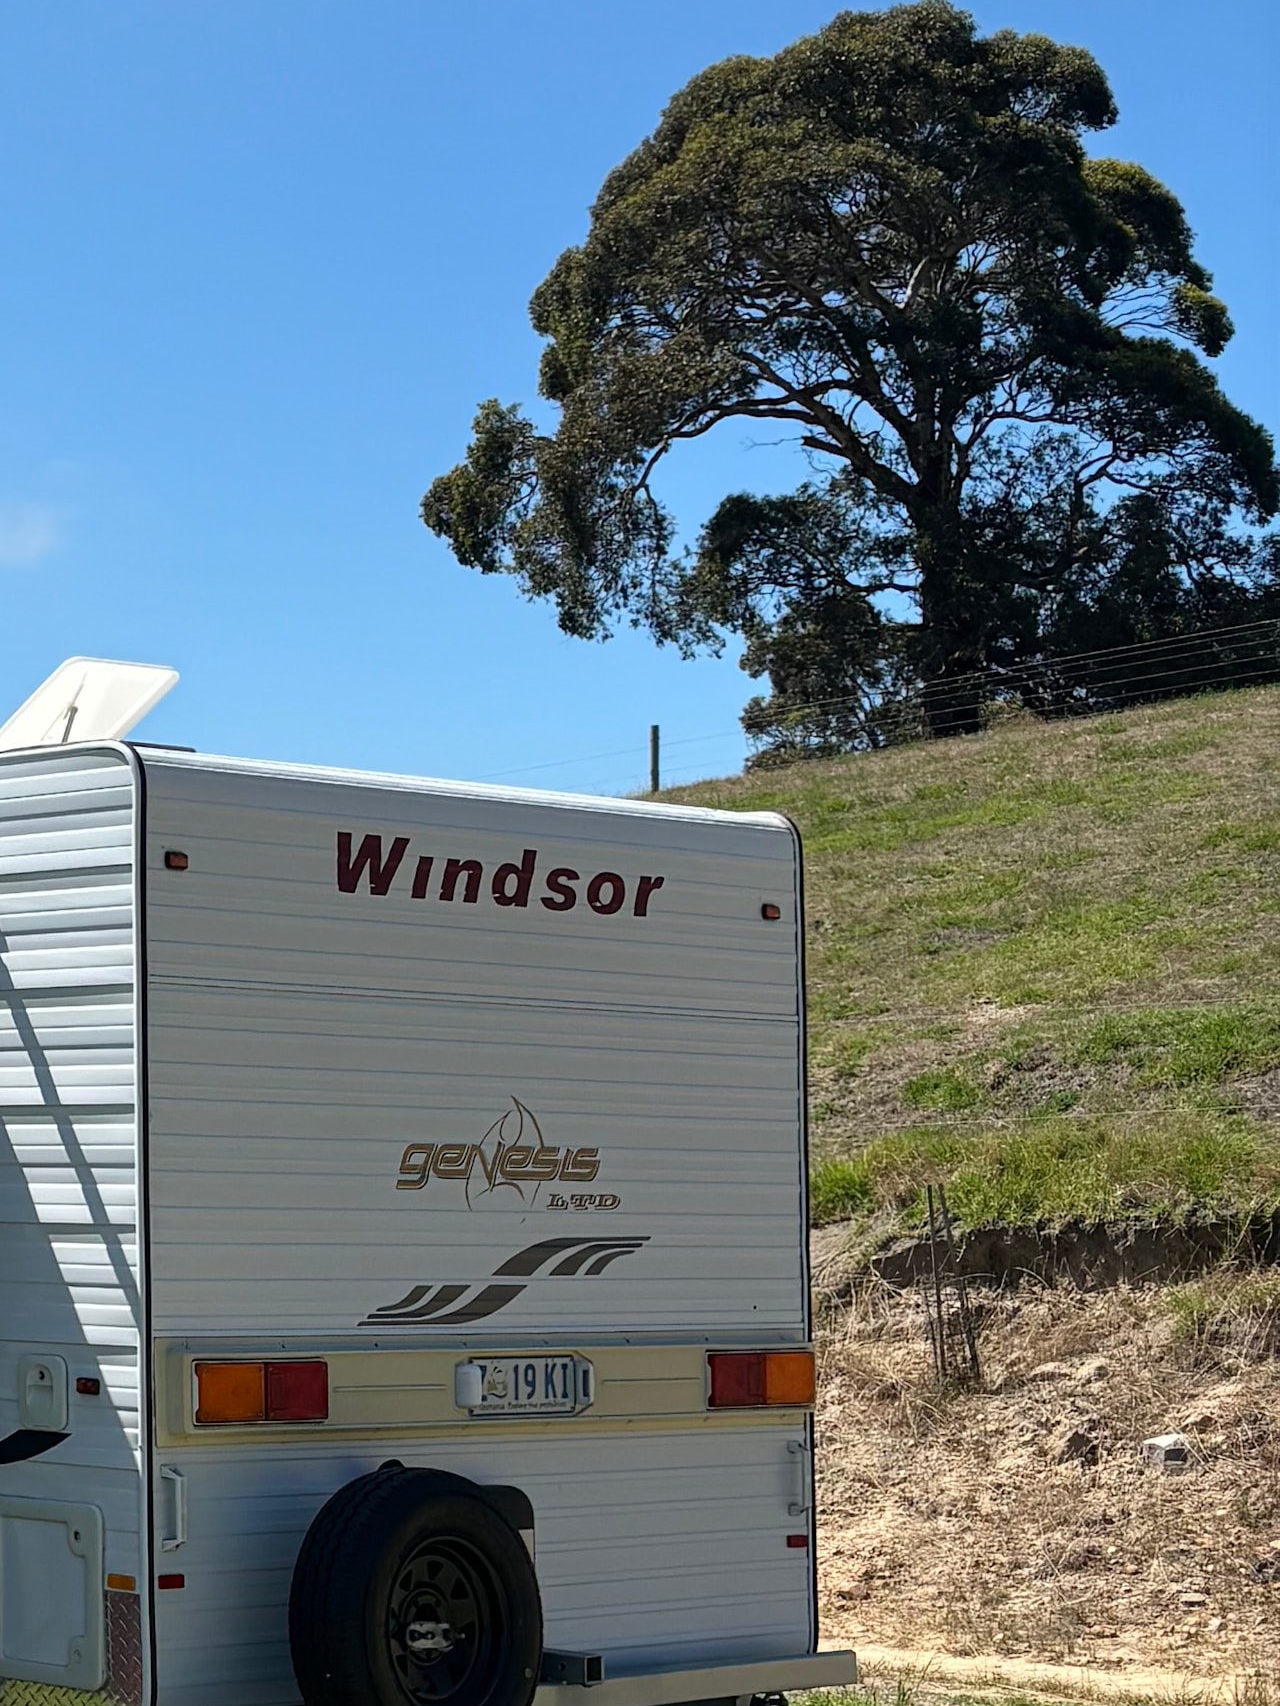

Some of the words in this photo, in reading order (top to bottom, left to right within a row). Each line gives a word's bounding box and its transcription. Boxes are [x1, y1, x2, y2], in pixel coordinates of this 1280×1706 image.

[336, 830, 665, 917] Windsor
[545, 1193, 621, 1211] LTD
[513, 1363, 536, 1401] 19
[545, 1363, 569, 1400] KI
